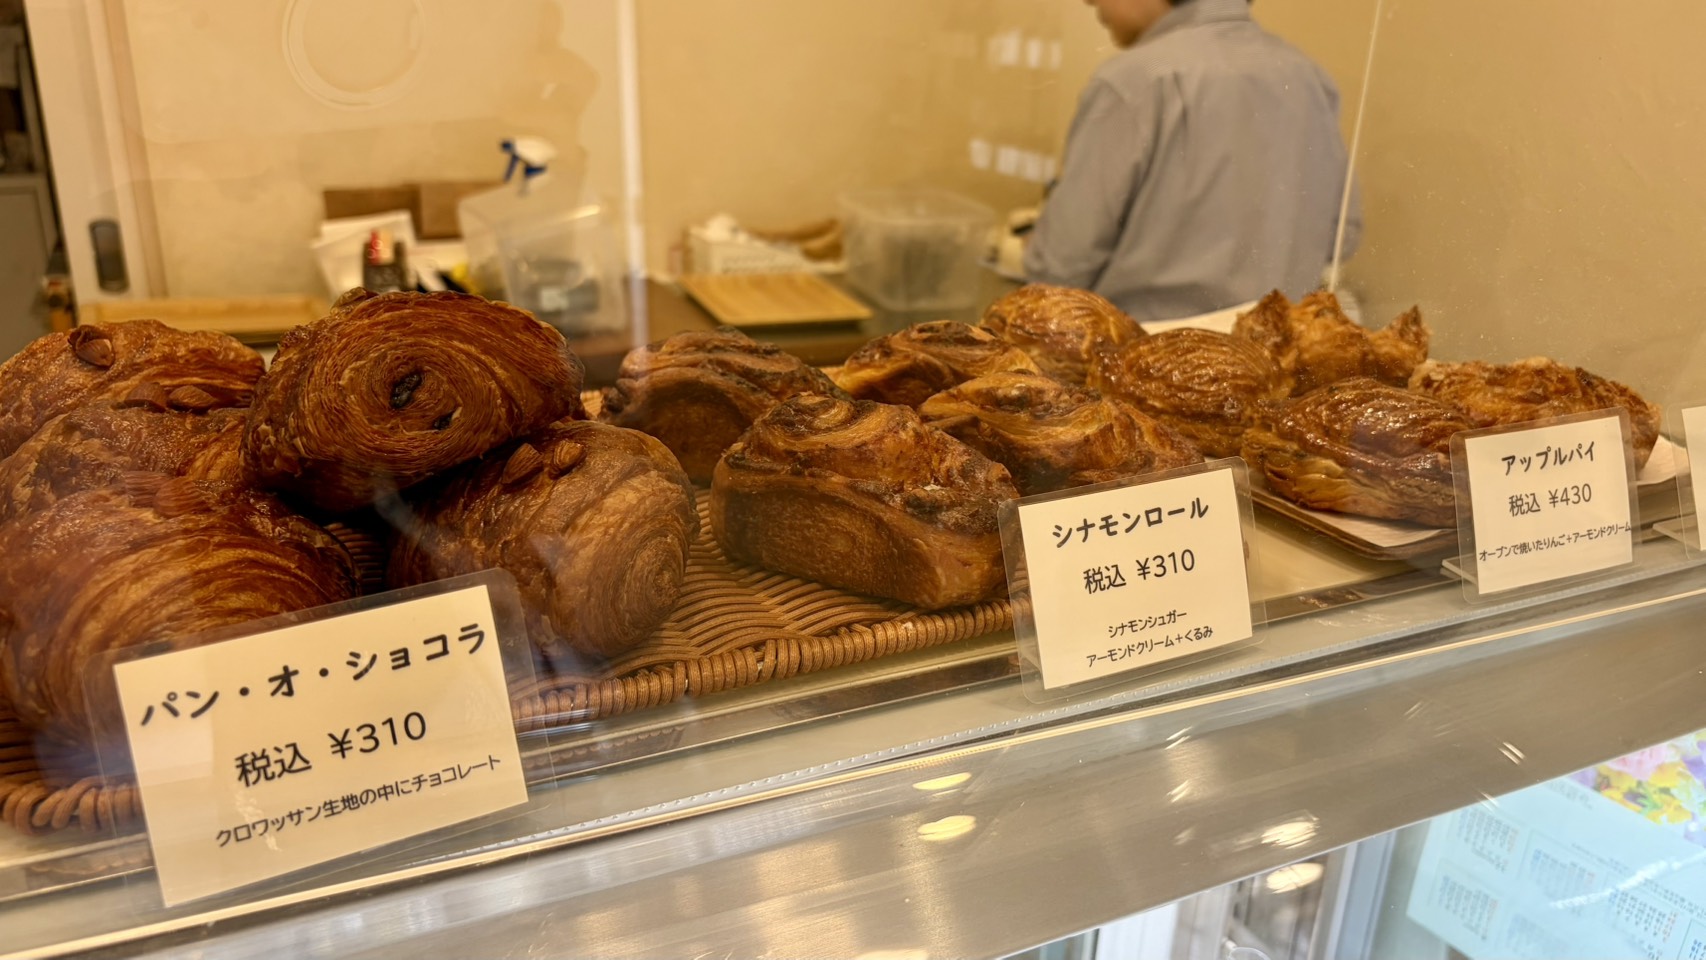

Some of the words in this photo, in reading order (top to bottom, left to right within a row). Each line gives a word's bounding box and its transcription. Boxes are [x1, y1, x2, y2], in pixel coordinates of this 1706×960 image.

[1501, 440, 1596, 476] アップルパイ
[1052, 496, 1210, 549] シナモンロール
[1508, 492, 1541, 518] 税込
[1548, 483, 1593, 509] ¥430
[1082, 563, 1127, 595] 税込
[1135, 548, 1196, 581] ¥310
[1108, 609, 1187, 639] シナモンシュガー
[139, 622, 487, 728] パン・オ・ショコラ
[234, 741, 313, 789] 税込
[327, 710, 428, 761] ¥310
[215, 752, 502, 849] クロワッサン生地の中にチョコレート
